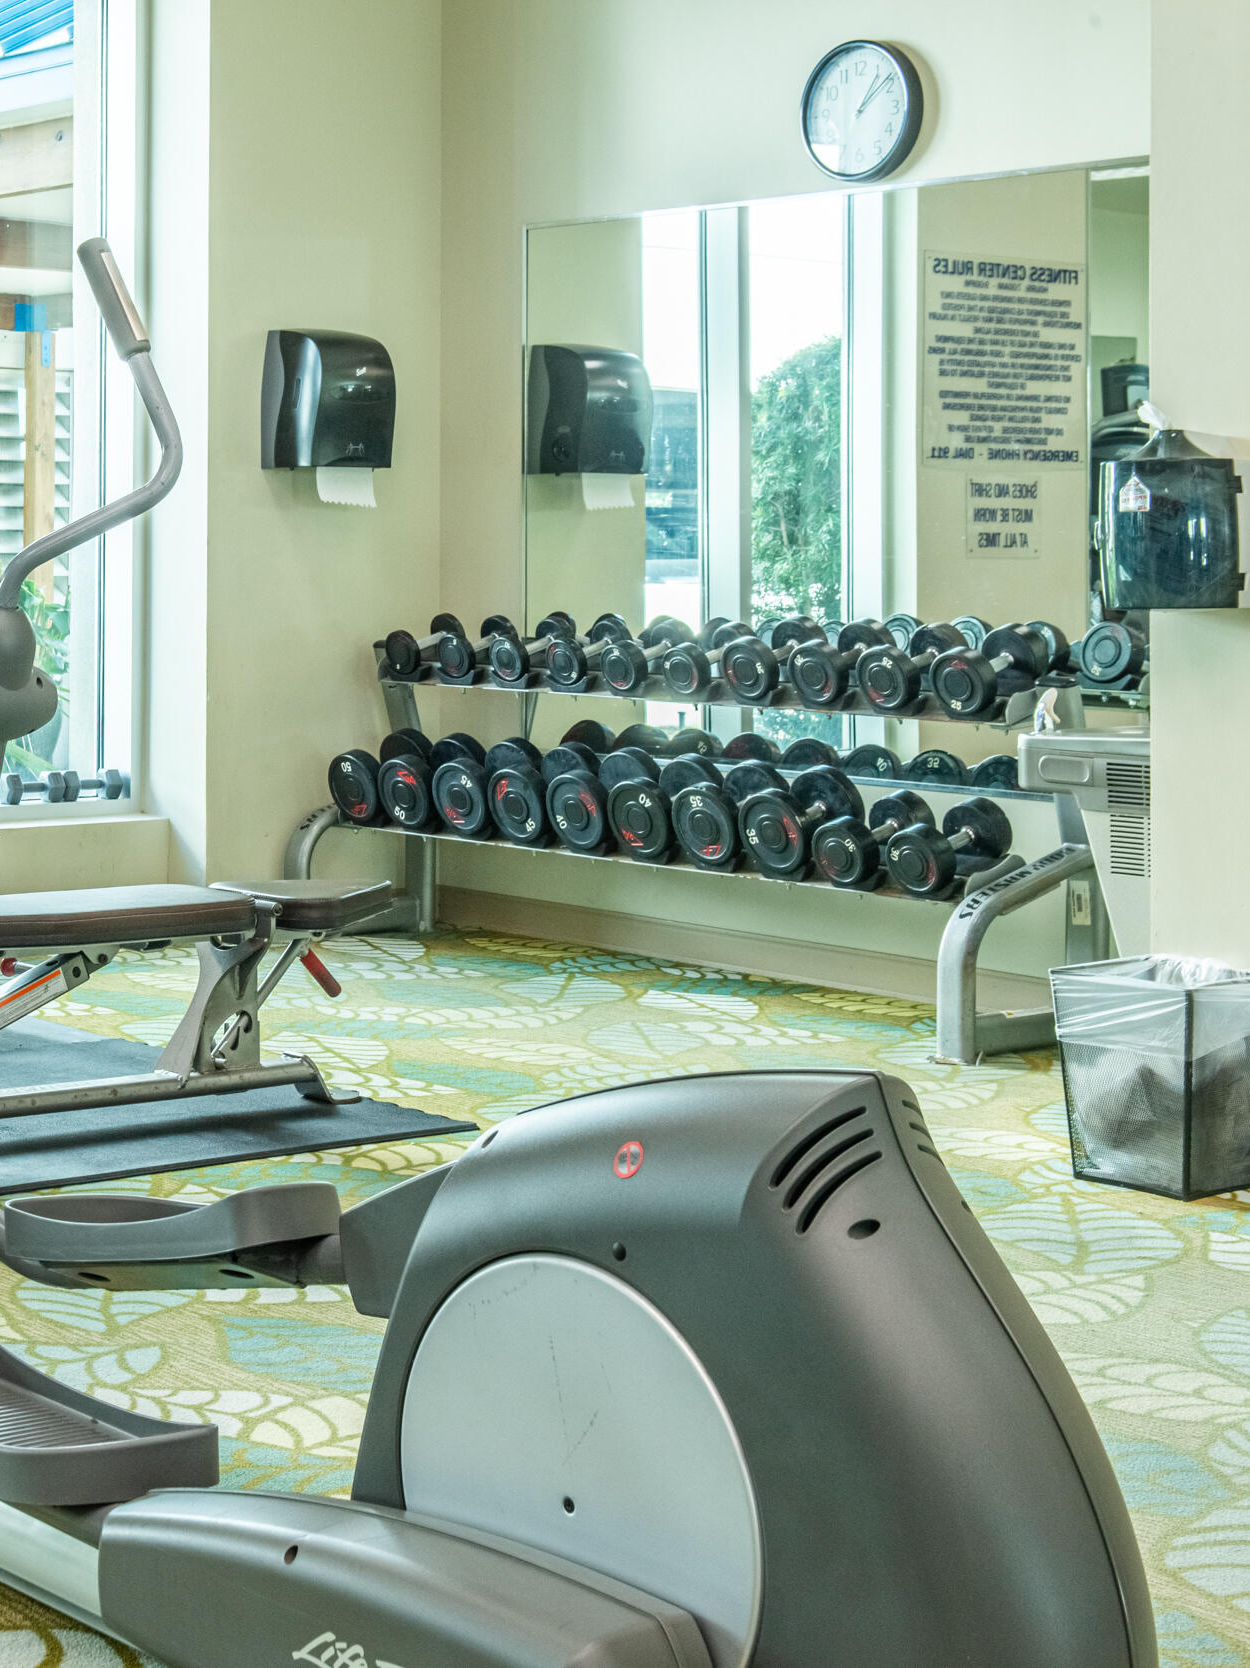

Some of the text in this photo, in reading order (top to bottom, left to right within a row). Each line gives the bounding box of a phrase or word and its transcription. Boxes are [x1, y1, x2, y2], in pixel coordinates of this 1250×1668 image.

[854, 60, 868, 76] 12
[840, 69, 849, 84] 11
[826, 86, 838, 101] 10
[892, 100, 900, 115] 3
[822, 109, 830, 122] 9
[885, 122, 893, 136] 4
[873, 140, 882, 155] 5
[855, 148, 864, 163] 6
[341, 761, 352, 772] 50
[461, 775, 472, 788] 45
[639, 794, 652, 808] 40
[690, 796, 702, 808] 35
[394, 806, 406, 820] 50
[525, 818, 536, 832] 45
[555, 815, 567, 830] 40
[746, 828, 759, 845] 35
[844, 838, 856, 852] 30
[890, 847, 899, 862] 30
